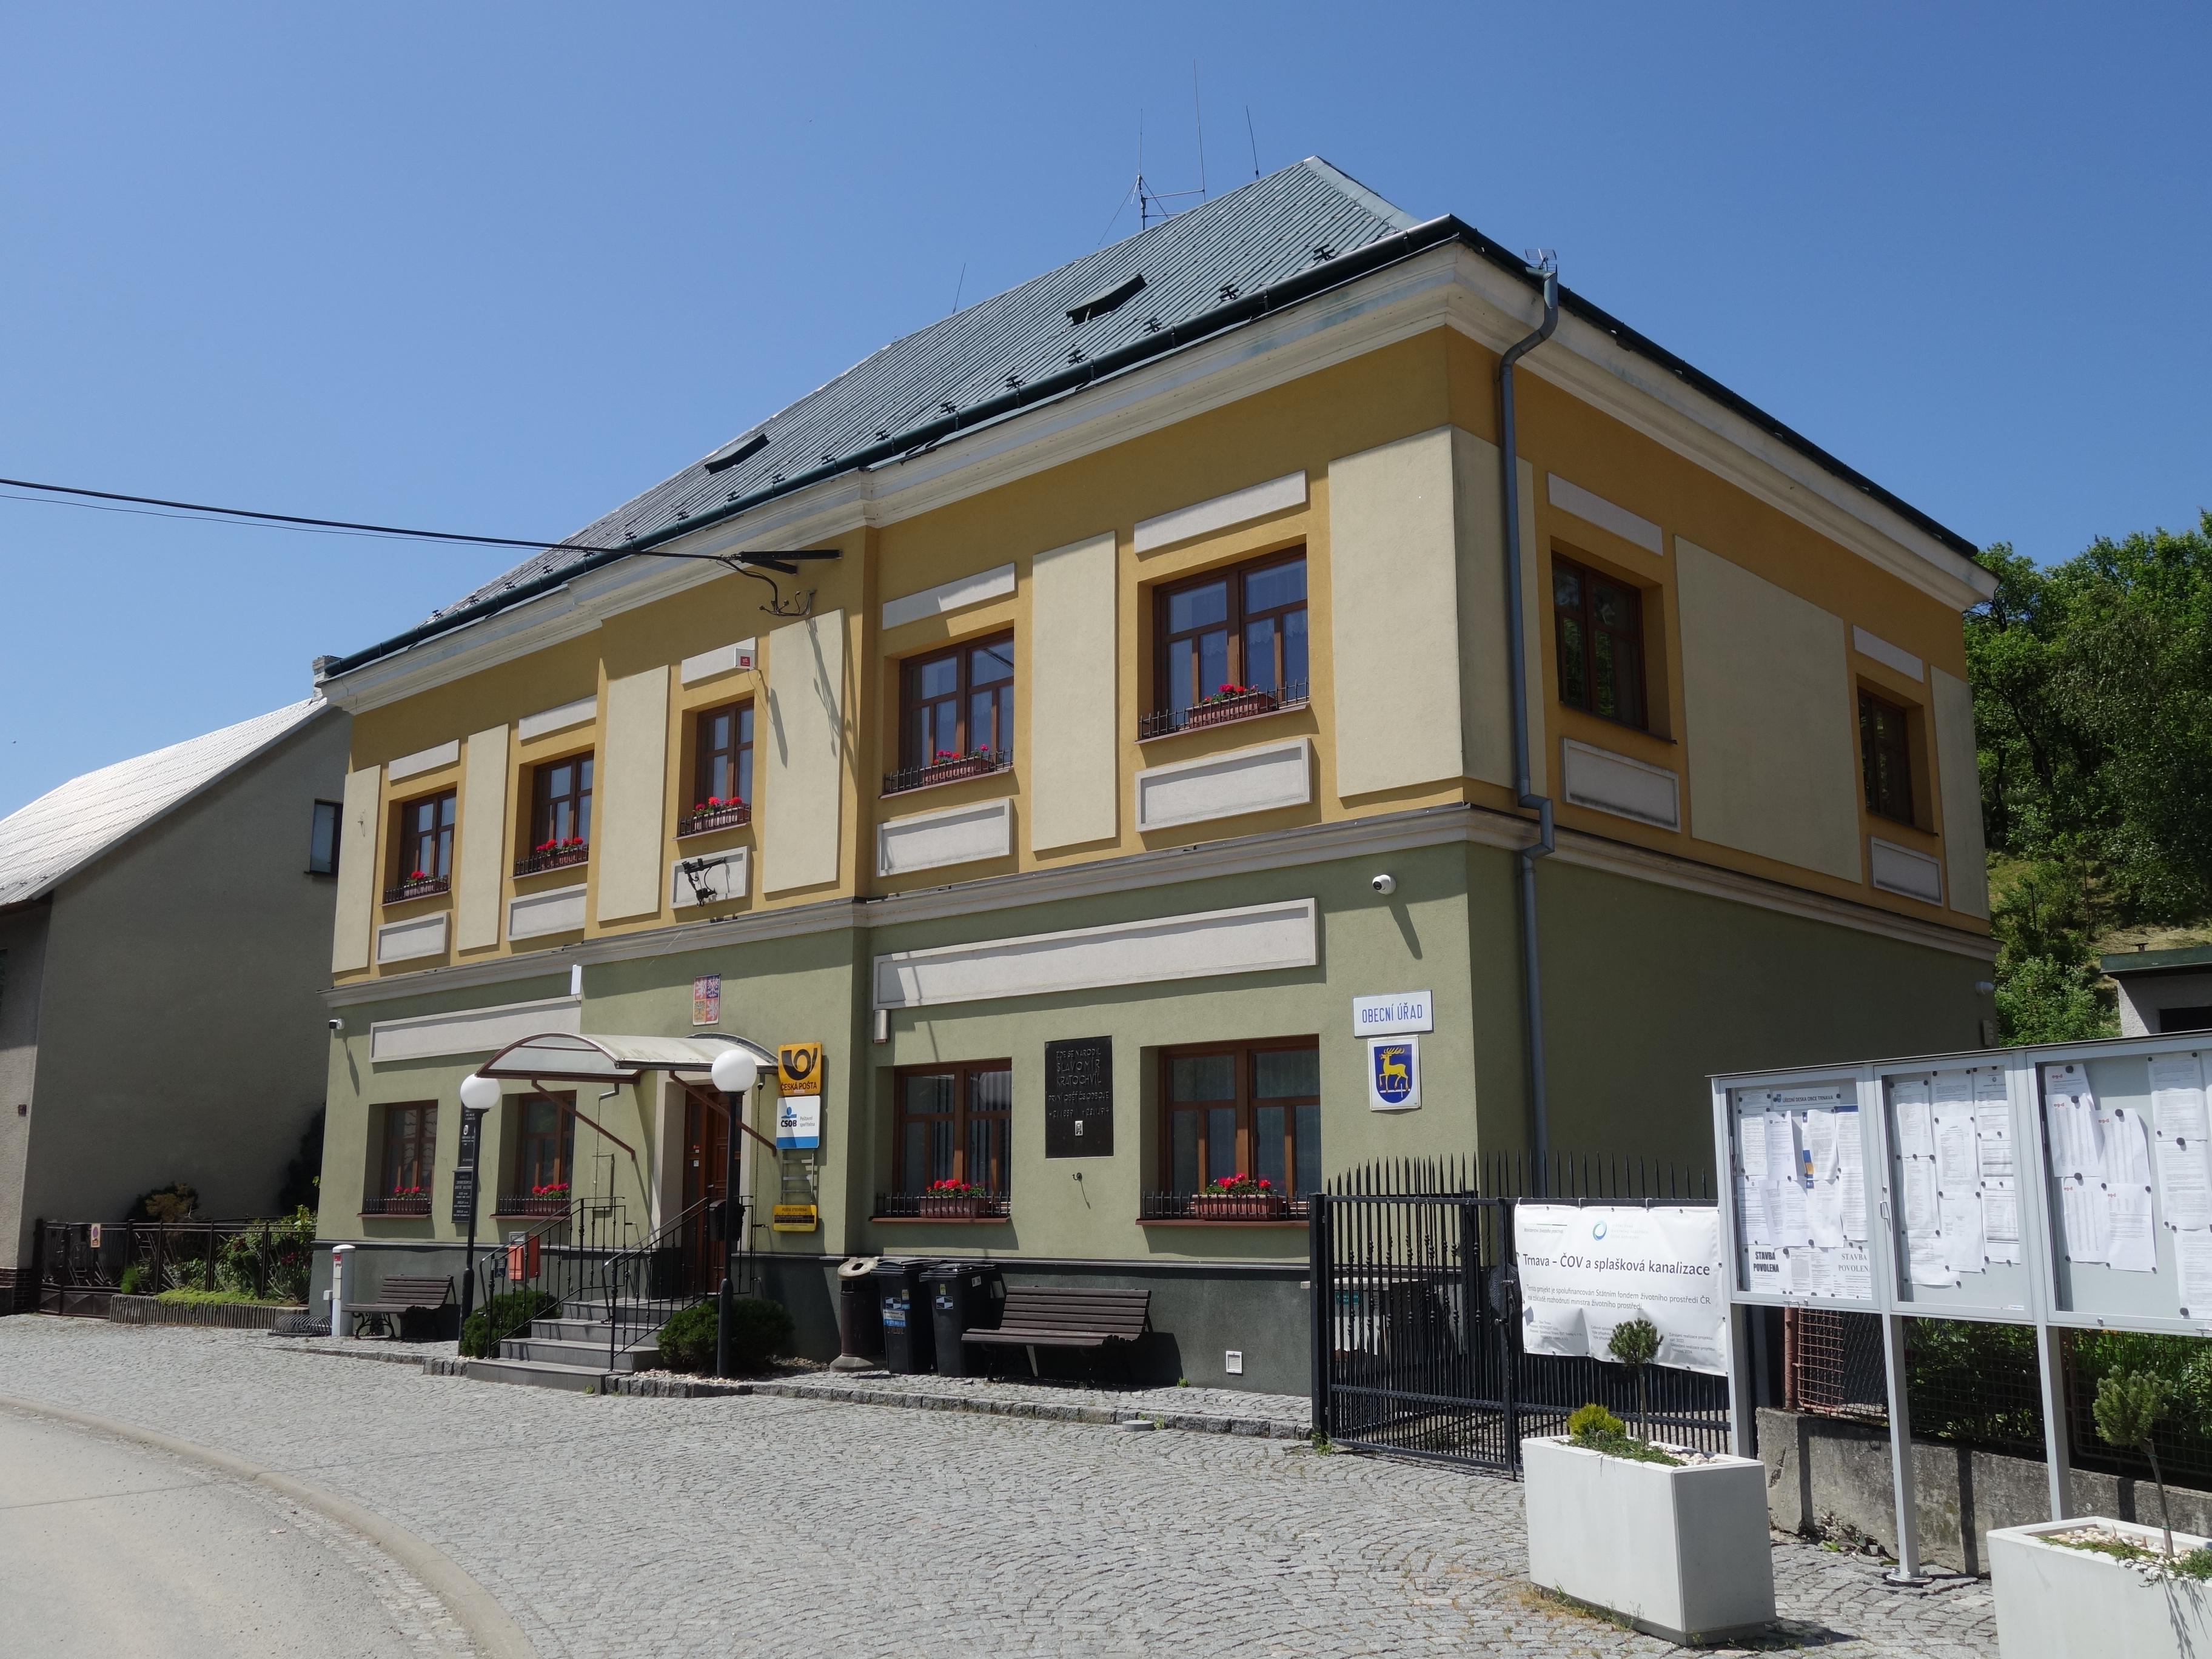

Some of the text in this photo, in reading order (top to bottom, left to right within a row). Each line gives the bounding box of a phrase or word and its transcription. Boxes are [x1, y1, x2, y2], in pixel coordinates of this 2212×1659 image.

[1362, 1002, 1423, 1023] OBECNÍ ÚŘAD
[1057, 1057, 1101, 1072] SLAVOMÍR
[1056, 1071, 1102, 1087] KRATOCHVÍL
[780, 1081, 817, 1091] ČESKÁ POŠTA
[780, 1119, 797, 1128] ČSOB
[1755, 1252, 1775, 1261] STAVBA
[1523, 1253, 1550, 1266] Trnava
[1560, 1253, 1584, 1268] ČOV
[1586, 1259, 1591, 1269] a
[1594, 1257, 1645, 1272] splašková
[1649, 1260, 1710, 1275] kanalizace
[1753, 1264, 1780, 1273] POVOLENA
[1556, 1287, 1594, 1296] spolufinancován
[1596, 1289, 1616, 1298] Státním
[1640, 1293, 1667, 1301] životního
[1669, 1296, 1698, 1304] prostředí
[1700, 1295, 1711, 1304] ČR
[1592, 1299, 1616, 1309] životního
